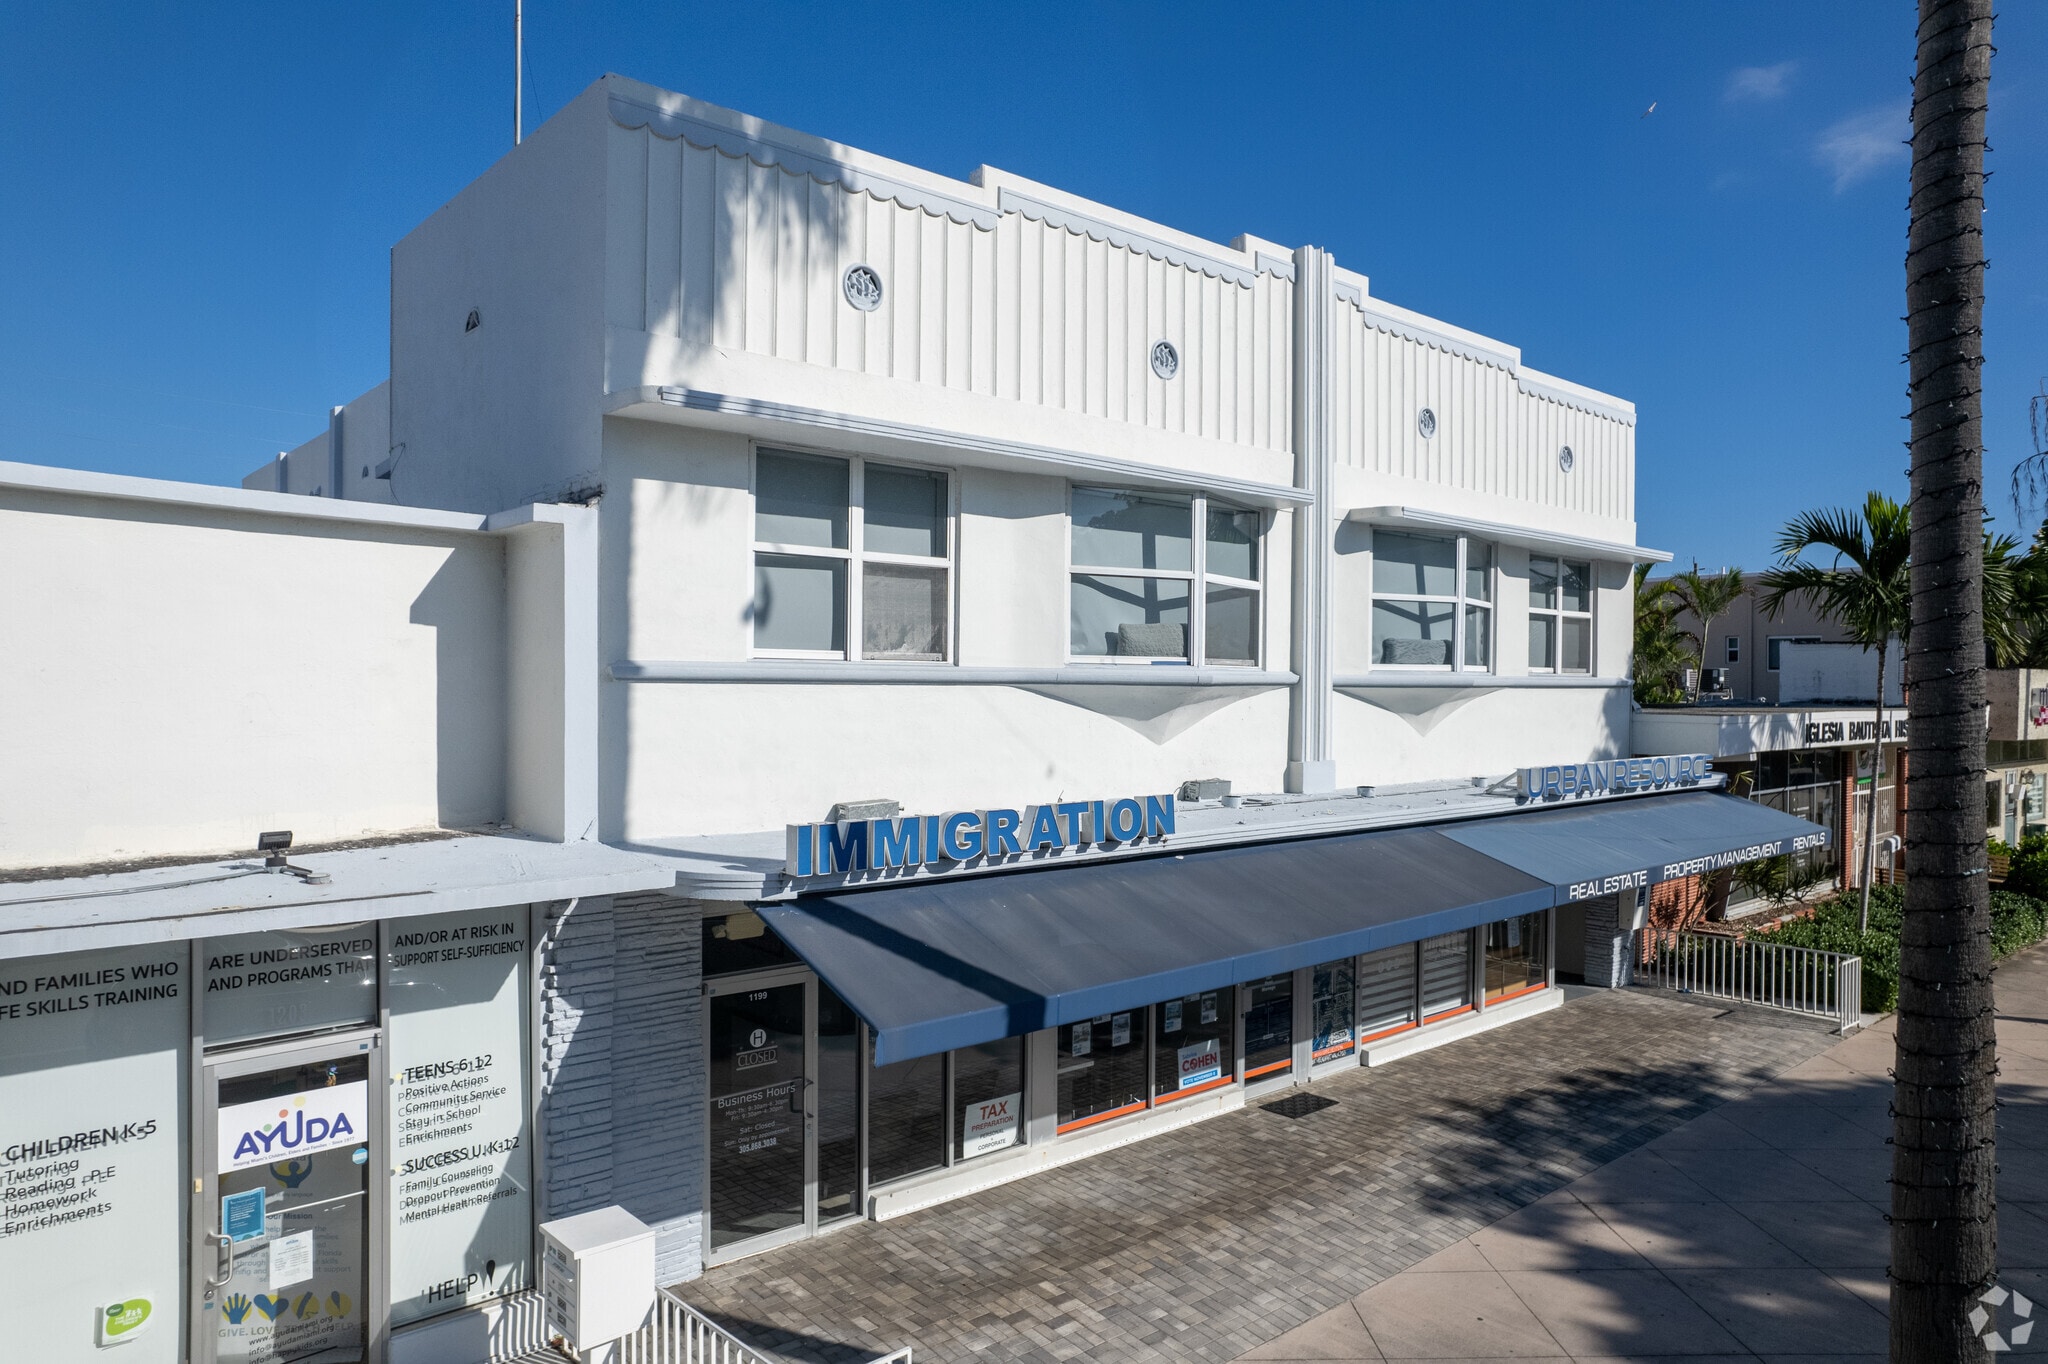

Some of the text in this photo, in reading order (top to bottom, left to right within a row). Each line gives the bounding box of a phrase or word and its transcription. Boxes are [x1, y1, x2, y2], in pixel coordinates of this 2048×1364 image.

[1805, 721, 1844, 743] IGLESIA
[1848, 720, 1891, 741] BAUTITA
[1526, 754, 1714, 799] URBAN RESOURCE
[787, 793, 1176, 877] IMMIGRATION
[1569, 880, 1603, 900] REAL
[1604, 870, 1648, 894] ESTATE
[1663, 857, 1717, 881] PROPERTY
[1717, 841, 1782, 868] MANAGEMENT
[1793, 832, 1826, 850] RENTALS
[394, 922, 514, 948] AND/OR AT RISK IN
[208, 938, 373, 971] ARE UNDERSERVED
[393, 939, 525, 968] SUPPORT SELF-SUFFICIENCY
[34, 968, 125, 992] FAMILIES
[131, 962, 178, 980] WHO
[207, 960, 371, 992] AND PROGRAMS THAT
[26, 995, 89, 1017] SKILLS
[94, 984, 178, 1007] TRAINING
[749, 991, 768, 1002] 1199
[405, 1060, 455, 1081] TEENS
[737, 1049, 777, 1068] CLOSED
[1182, 1052, 1218, 1072] COHEN
[405, 1074, 489, 1099] Positive Actions
[405, 1086, 507, 1114] Community Service
[718, 1085, 796, 1109] Business Hours
[405, 1104, 481, 1131] Stay in School
[971, 1115, 1014, 1132] PREPARATION
[980, 1100, 1009, 1120] TAX
[233, 1109, 354, 1160] AYUDA
[405, 1122, 473, 1144] Enrichments
[754, 1120, 776, 1131] Closed
[980, 1128, 1004, 1139] PERSONAL
[5, 1119, 157, 1162] CHILDREN K-5
[977, 1138, 1007, 1151] CORPORATE
[406, 1147, 468, 1173] SUCCESS
[489, 1136, 520, 1154] K-12
[5, 1159, 80, 1182] Tutoring
[405, 1164, 494, 1193] Family Counseling
[5, 1187, 98, 1218] Homework
[406, 1177, 501, 1207] Dropout Prevention
[406, 1186, 518, 1222] Mental Health Referrals
[5, 1202, 112, 1235] Enrichments
[283, 1212, 313, 1220] Mission
